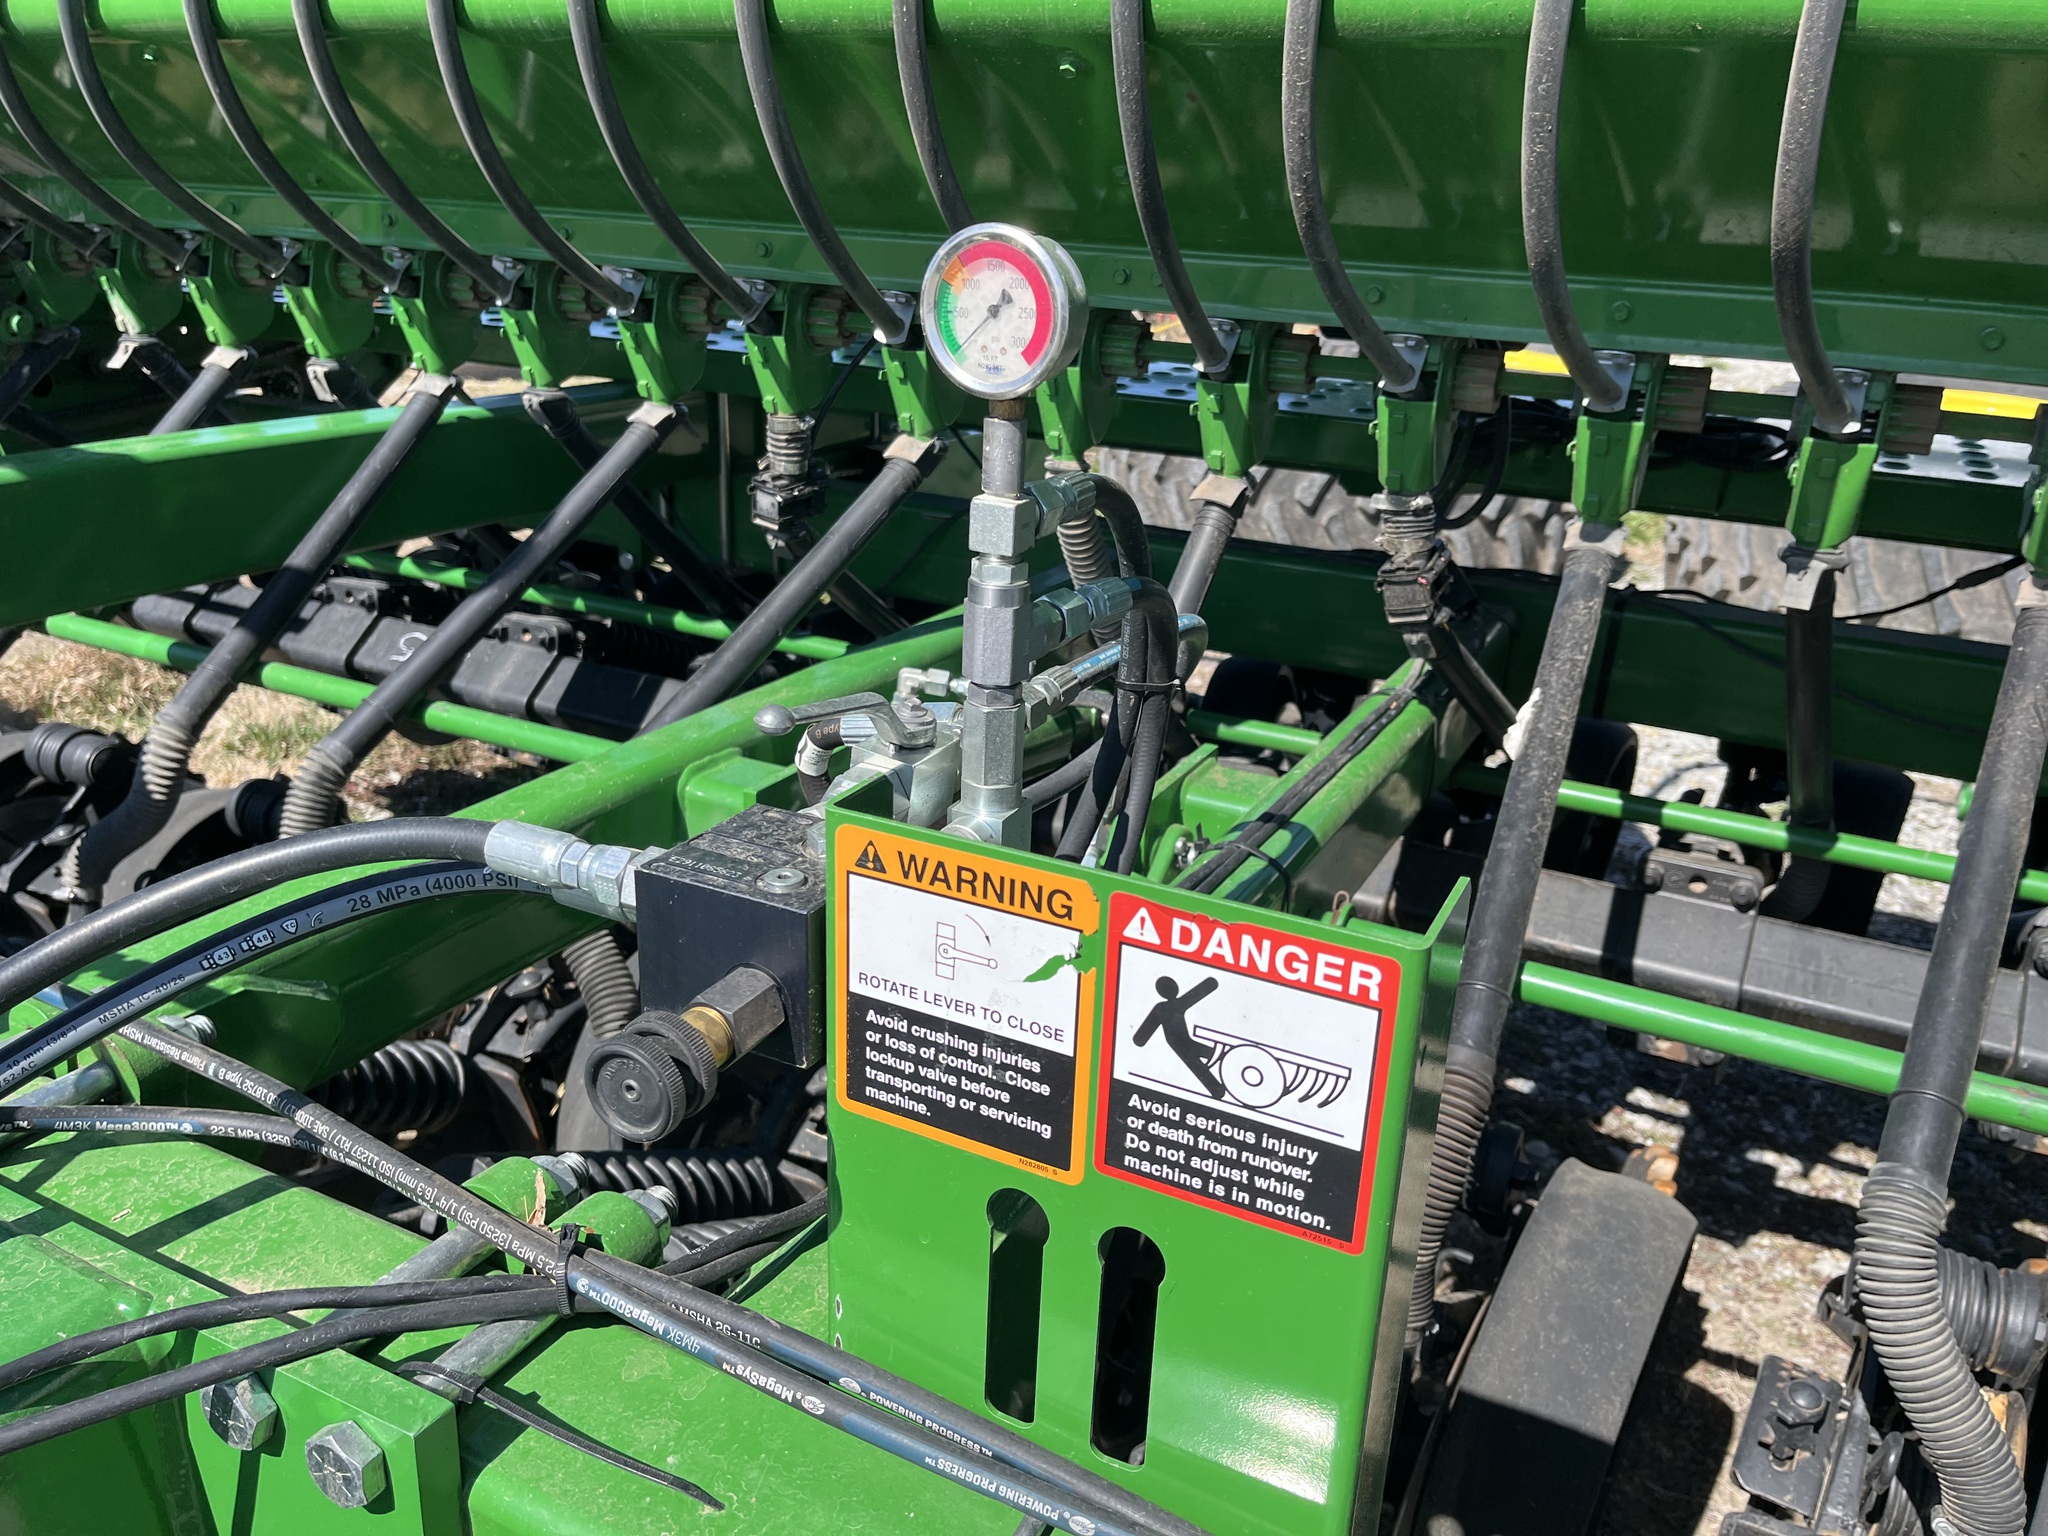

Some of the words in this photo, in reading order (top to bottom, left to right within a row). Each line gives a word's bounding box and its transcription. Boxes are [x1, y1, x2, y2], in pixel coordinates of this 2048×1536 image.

[987, 260, 1006, 272] 1500
[962, 278, 980, 290] 1000
[1009, 277, 1030, 290] 2000
[954, 307, 969, 319] 500
[898, 850, 1074, 921] WARNING
[98, 1001, 135, 1025] MSHA
[217, 950, 231, 962] 43
[256, 933, 269, 944] 48
[285, 921, 296, 930] TC
[346, 894, 371, 913] 28
[376, 885, 421, 905] MPa
[425, 873, 476, 893] (4000
[483, 872, 519, 888] PSI)
[1170, 917, 1382, 1002] DANGER
[858, 972, 918, 1001] ROTATE
[924, 991, 975, 1017] LEVER
[981, 1007, 1002, 1023] TO
[1007, 1015, 1065, 1043] CLOSE
[144, 1033, 181, 1061] Resistant
[866, 1009, 908, 1033] Avoid
[911, 1023, 978, 1056] crushing
[982, 1043, 1041, 1073] injuries
[7, 1059, 20, 1071] 10
[23, 1046, 44, 1061] mm
[181, 1051, 206, 1071] Flame
[866, 1031, 882, 1043] or
[885, 1033, 916, 1055] loss
[920, 1047, 936, 1061] of
[938, 1050, 997, 1080] control.
[1005, 1070, 1051, 1096] Close
[218, 1067, 226, 1080] B
[224, 1070, 243, 1089] Type
[866, 1046, 915, 1073] lockup
[918, 1064, 958, 1087] valve
[961, 1076, 1011, 1104] before
[243, 1079, 268, 1101] 18752
[267, 1092, 281, 1107] ISO
[865, 1066, 956, 1109] transporting
[959, 1098, 976, 1112] or
[979, 1103, 1052, 1139] servicing
[866, 1085, 932, 1116] machine.
[210, 1125, 235, 1138] 22.5
[238, 1128, 260, 1140] MPa
[262, 1130, 292, 1146] (3250
[312, 1120, 330, 1138] SAE
[1128, 1094, 1181, 1122] Avoid
[1185, 1112, 1256, 1144] serious
[1262, 1133, 1319, 1166] injury
[334, 1134, 352, 1152] R17
[1127, 1117, 1145, 1130] or
[1148, 1120, 1194, 1146] death
[1198, 1135, 1237, 1160] from
[1241, 1151, 1313, 1183] runover.
[351, 1144, 380, 1168] 11237
[1019, 1158, 1049, 1173] N282805
[1125, 1133, 1150, 1153] Do
[1155, 1143, 1186, 1164] not
[1190, 1155, 1249, 1184] adjust
[1254, 1175, 1305, 1201] while
[378, 1160, 395, 1178] ISO
[395, 1168, 417, 1188] mm)
[1124, 1154, 1202, 1190] machine
[1208, 1179, 1225, 1197] is
[1231, 1187, 1250, 1205] in
[1256, 1196, 1332, 1231] motion.
[457, 1206, 480, 1229] PSI)
[480, 1221, 512, 1249] (3250
[512, 1244, 536, 1263] MPa
[667, 1326, 700, 1354] 4M3K
[870, 1391, 923, 1424] POWERING
[999, 1485, 1059, 1521] POWERING
